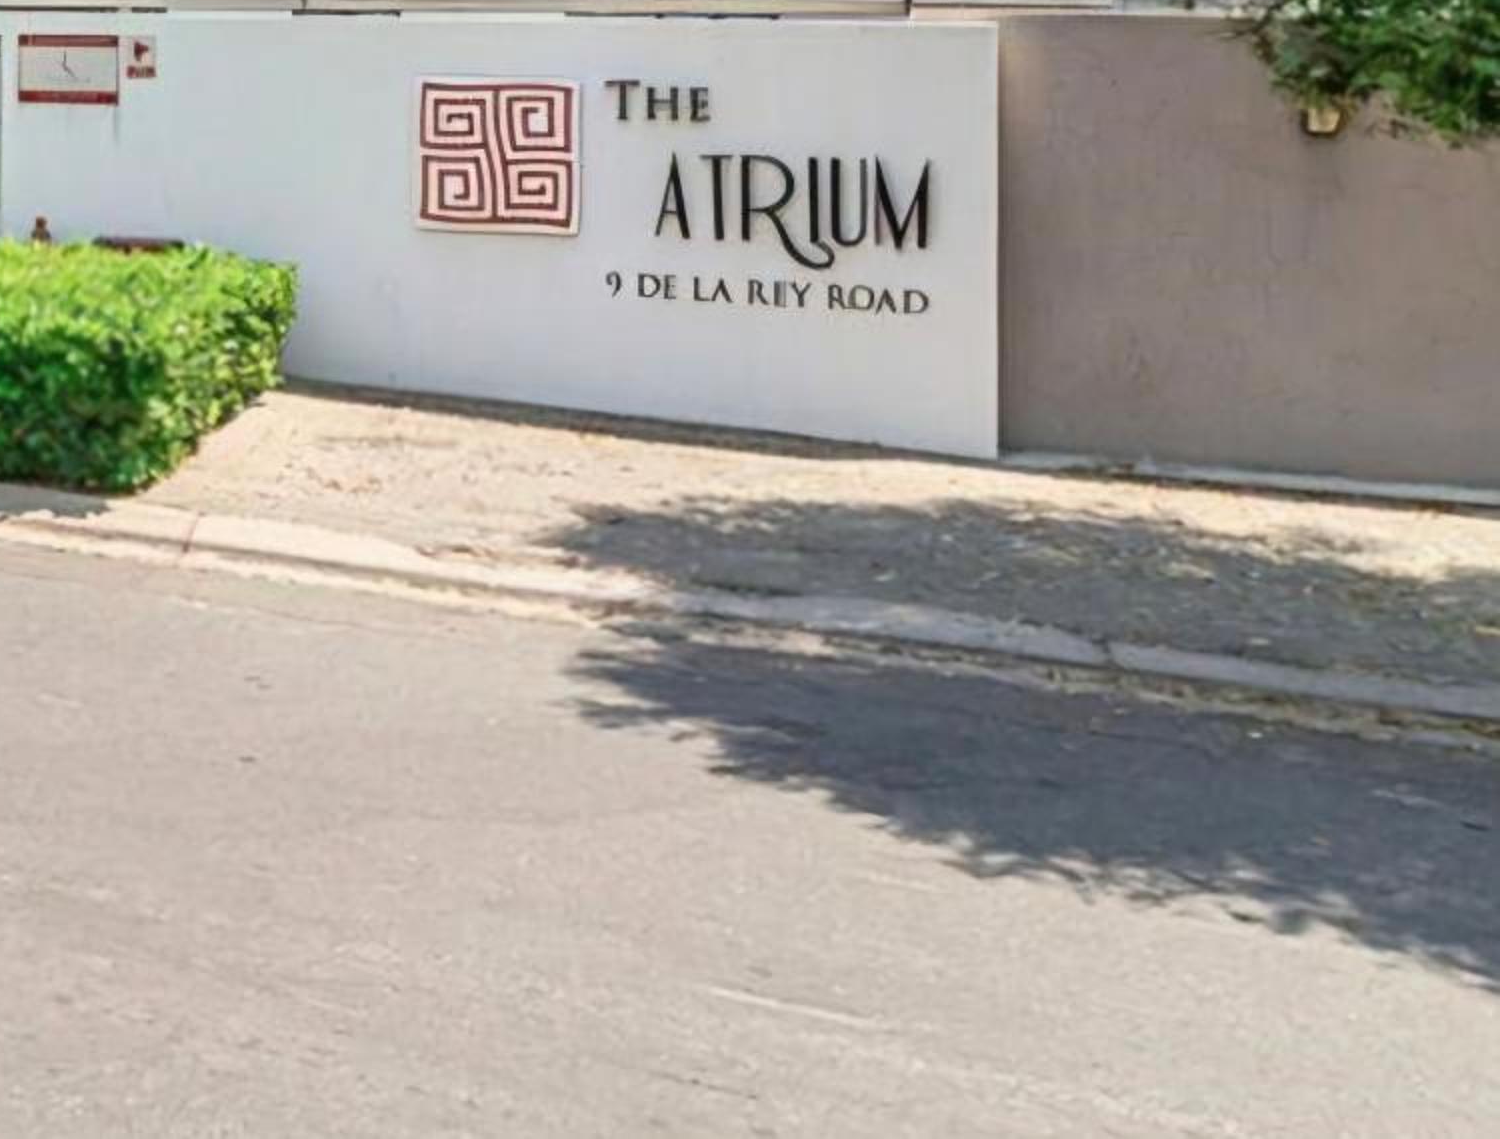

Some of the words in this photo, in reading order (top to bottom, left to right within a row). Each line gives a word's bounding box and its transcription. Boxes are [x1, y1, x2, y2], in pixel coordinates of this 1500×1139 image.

[604, 79, 712, 124] THE
[654, 150, 934, 270] ATRIUM
[605, 271, 622, 299] 9
[637, 273, 678, 301] DE
[693, 276, 734, 305] LA
[747, 279, 813, 309] REY
[827, 283, 931, 315] ROAD
